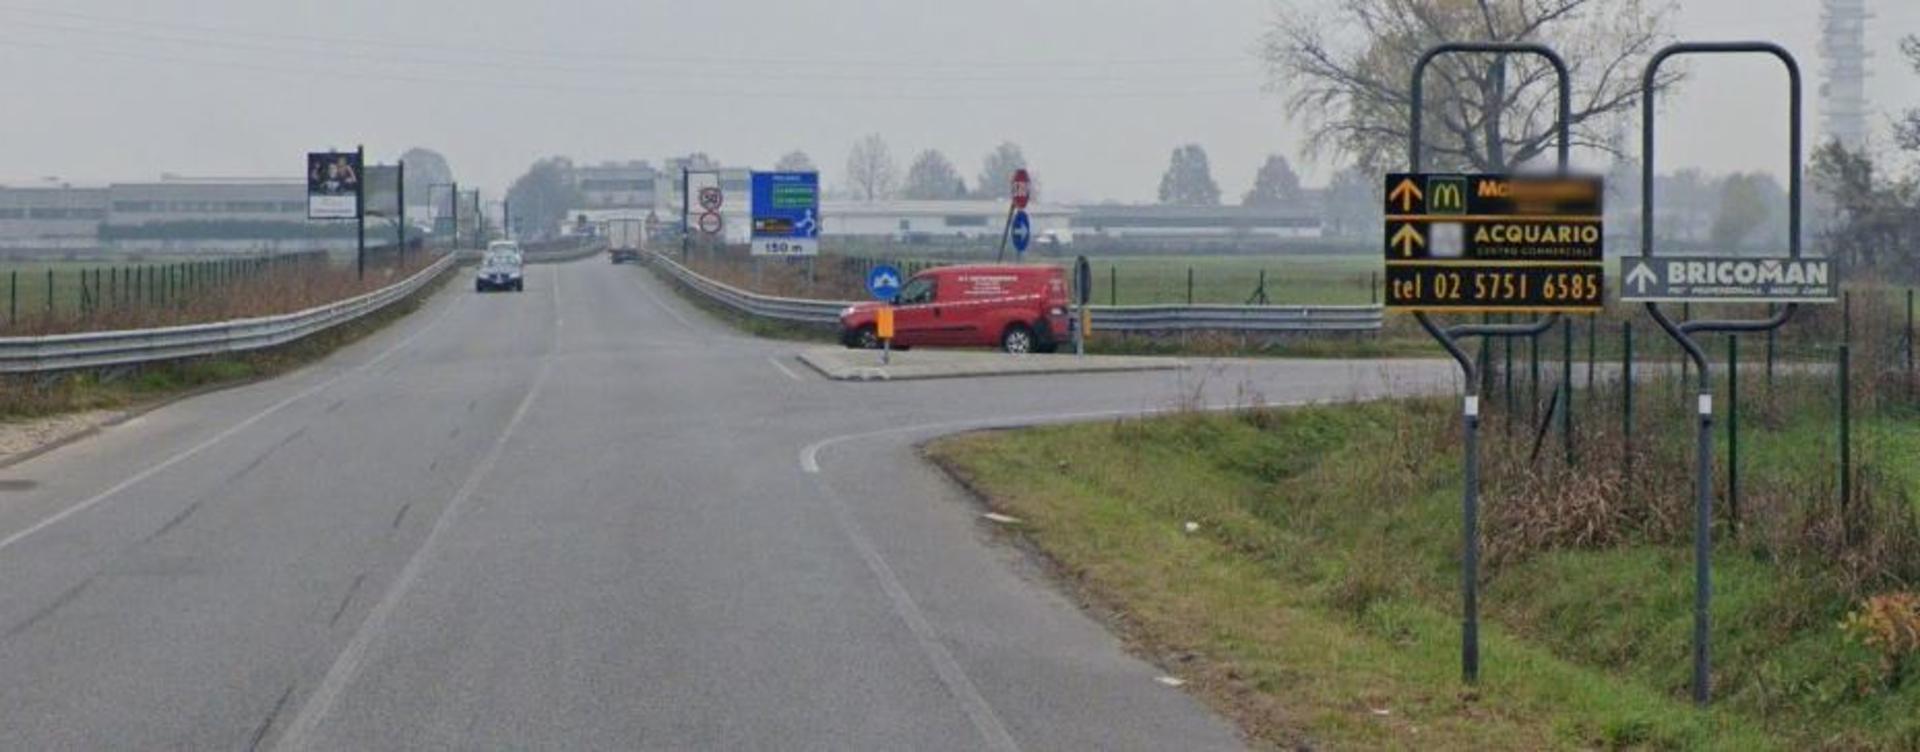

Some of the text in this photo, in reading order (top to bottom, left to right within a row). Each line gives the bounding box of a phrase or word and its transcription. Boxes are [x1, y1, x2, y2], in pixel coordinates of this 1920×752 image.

[1474, 225, 1598, 244] ACQUARIO
[1667, 260, 1829, 285] BRICOMAN
[1393, 272, 1598, 299] tel 02 5751 6585
